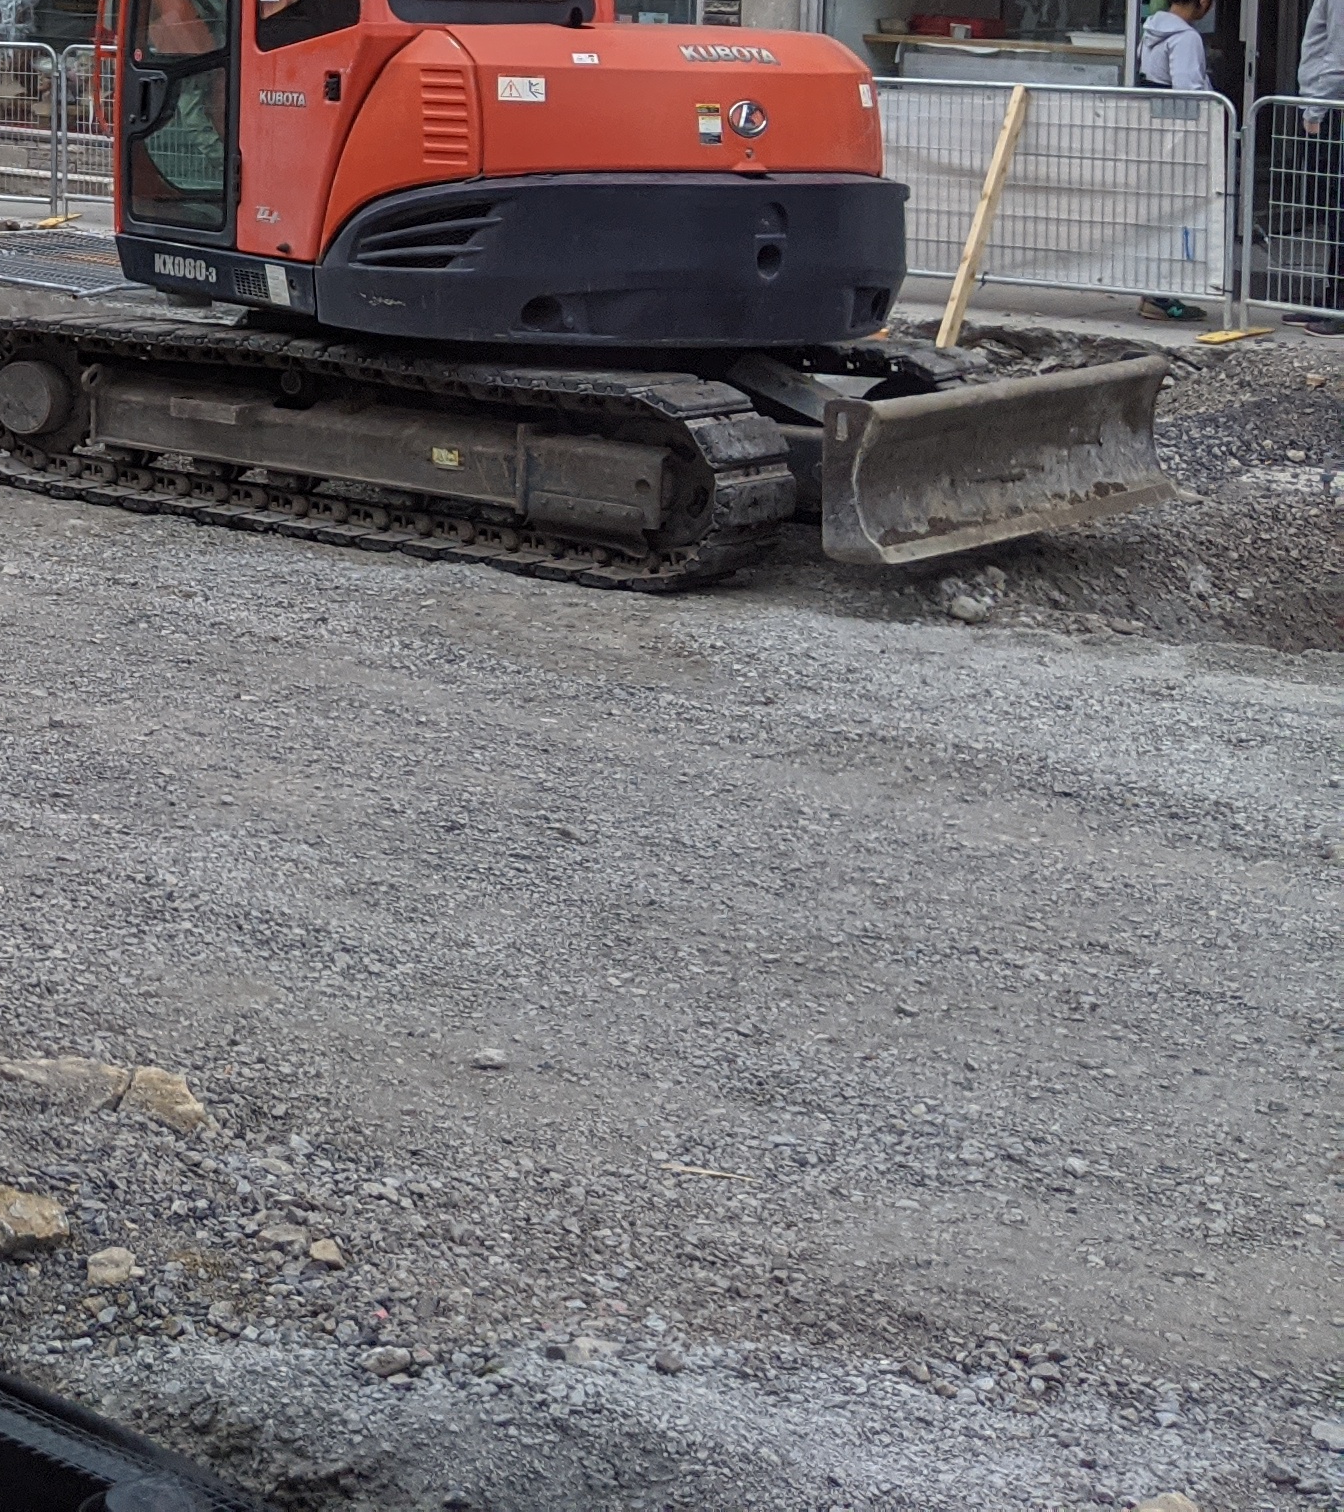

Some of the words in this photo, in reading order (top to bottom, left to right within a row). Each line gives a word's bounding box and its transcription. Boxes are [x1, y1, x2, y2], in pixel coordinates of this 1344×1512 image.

[679, 44, 780, 66] KUBOTA
[259, 89, 306, 107] KUBOTA
[154, 253, 217, 283] KX080-3
